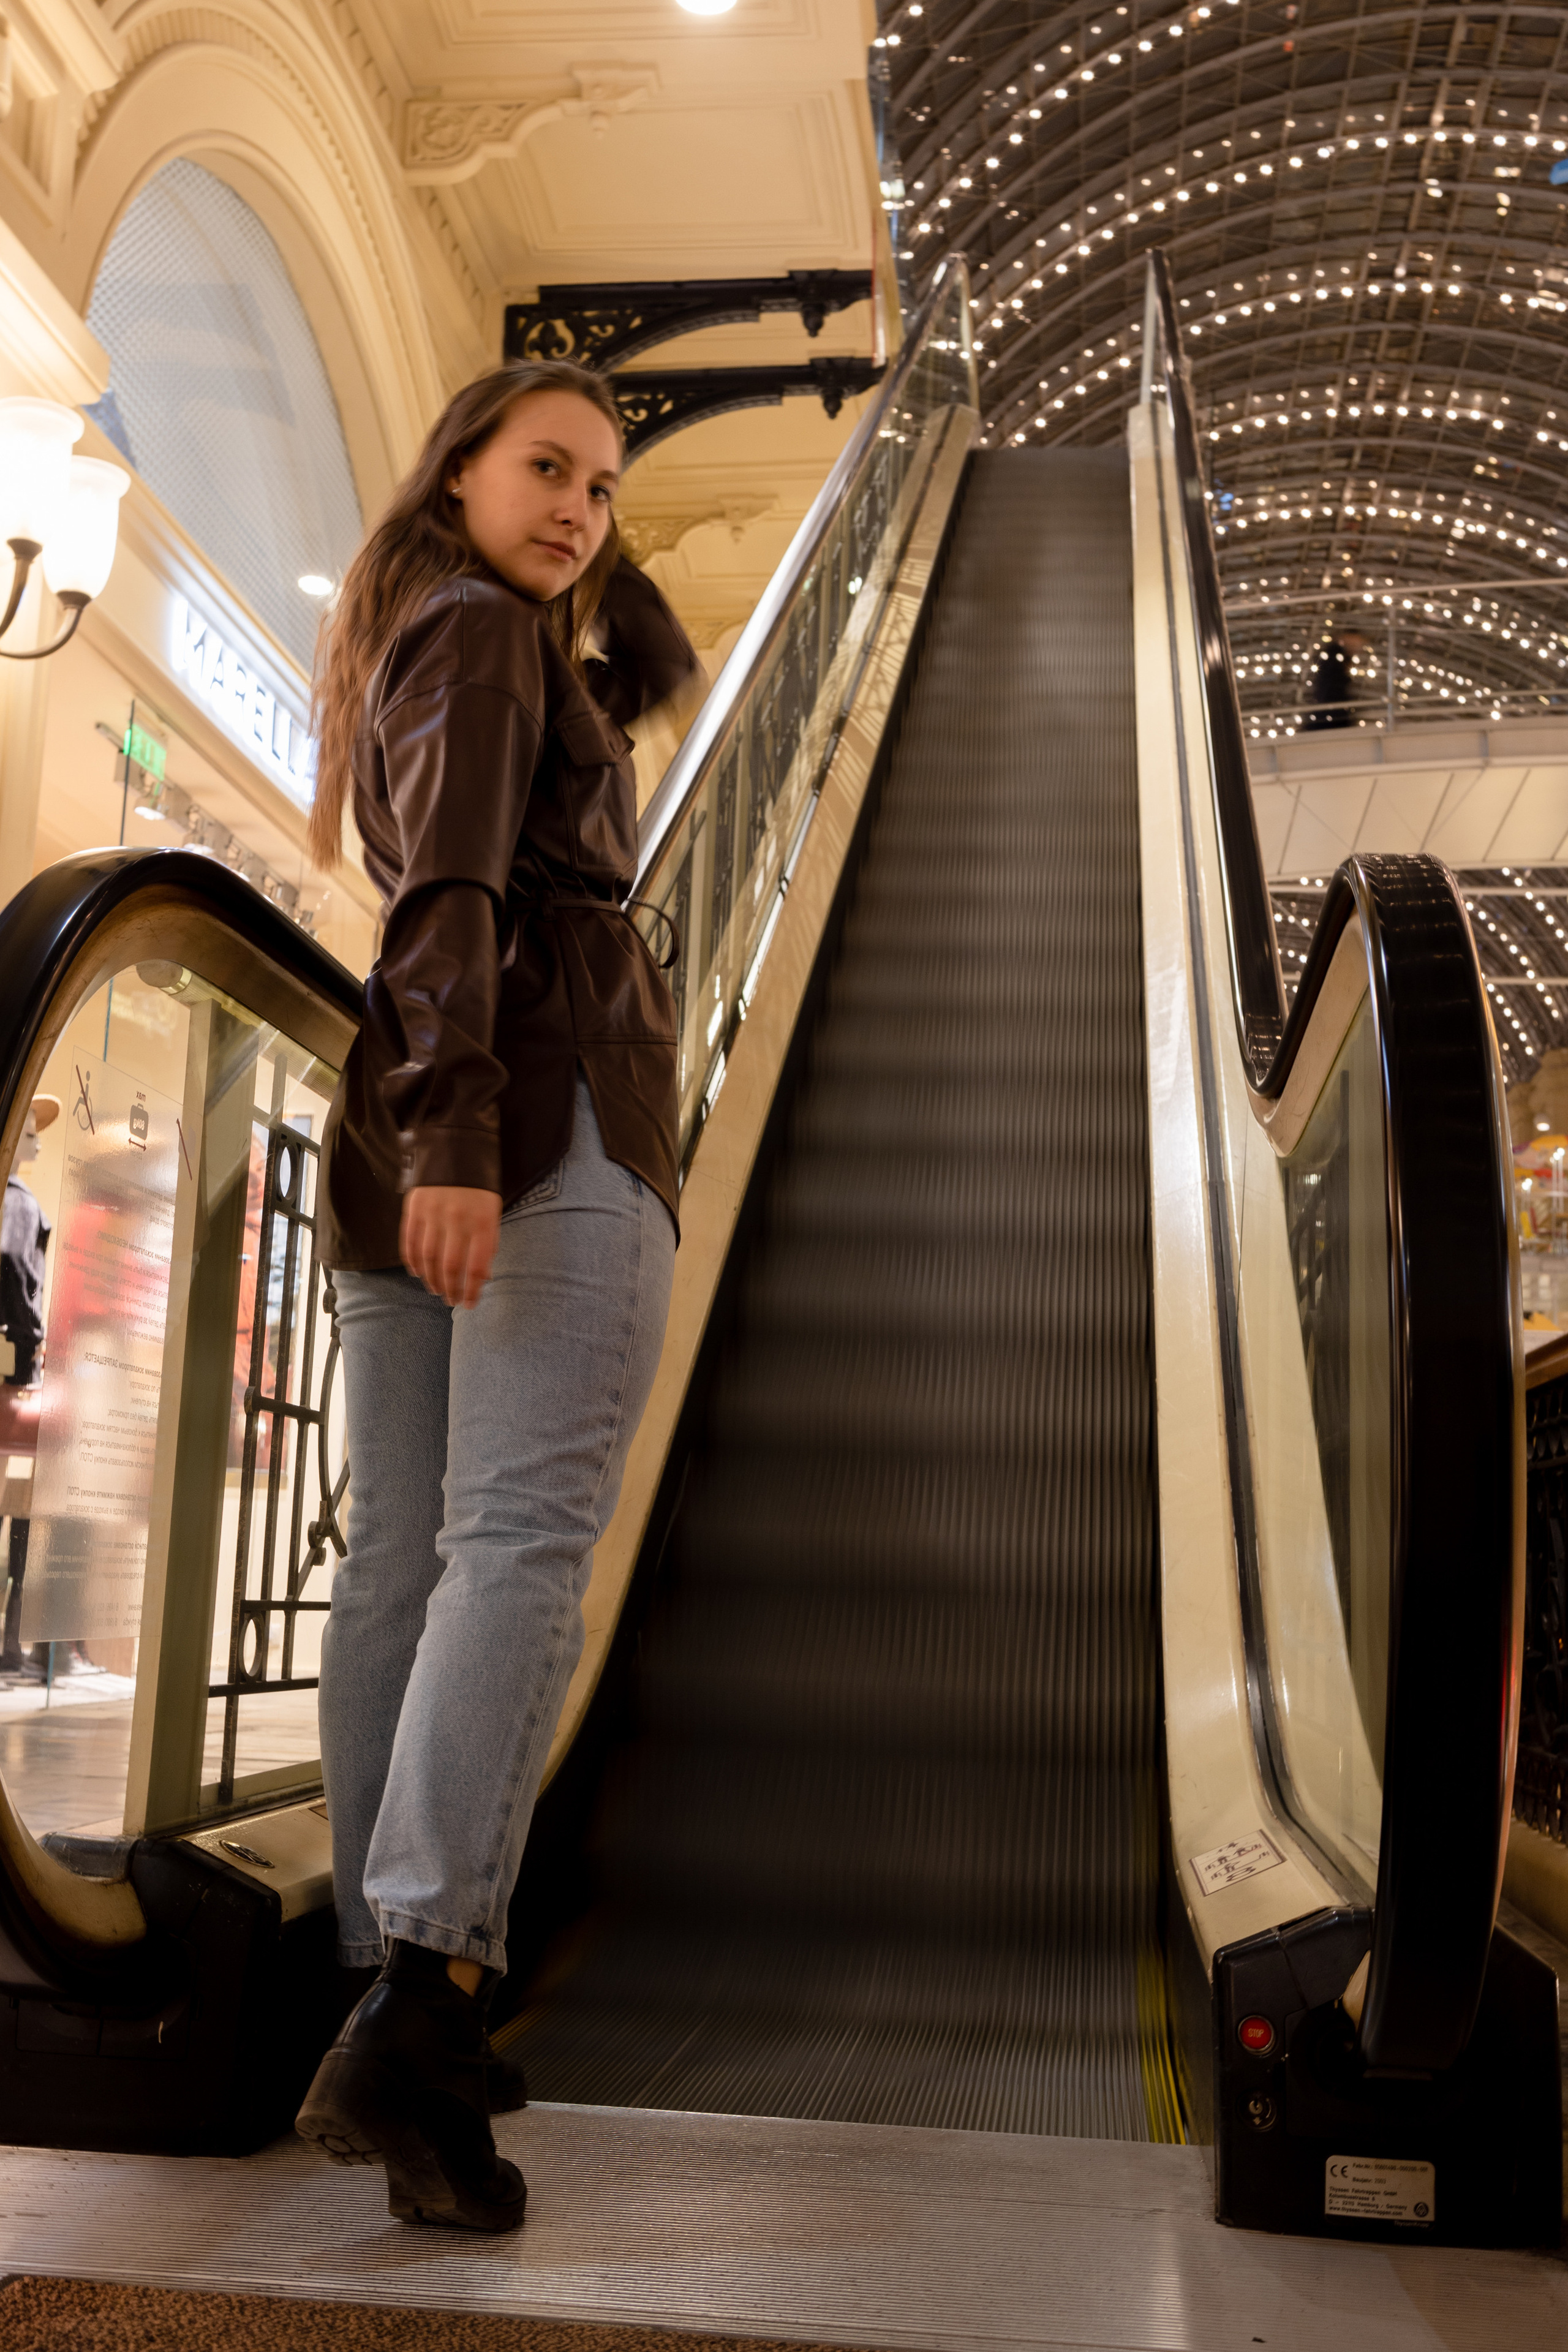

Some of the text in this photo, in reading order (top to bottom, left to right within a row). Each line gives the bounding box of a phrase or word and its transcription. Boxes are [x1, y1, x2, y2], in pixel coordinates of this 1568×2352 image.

[171, 597, 315, 804] MARELL
[1248, 2028, 1265, 2038] STOP
[1330, 2164, 1348, 2178] CE
